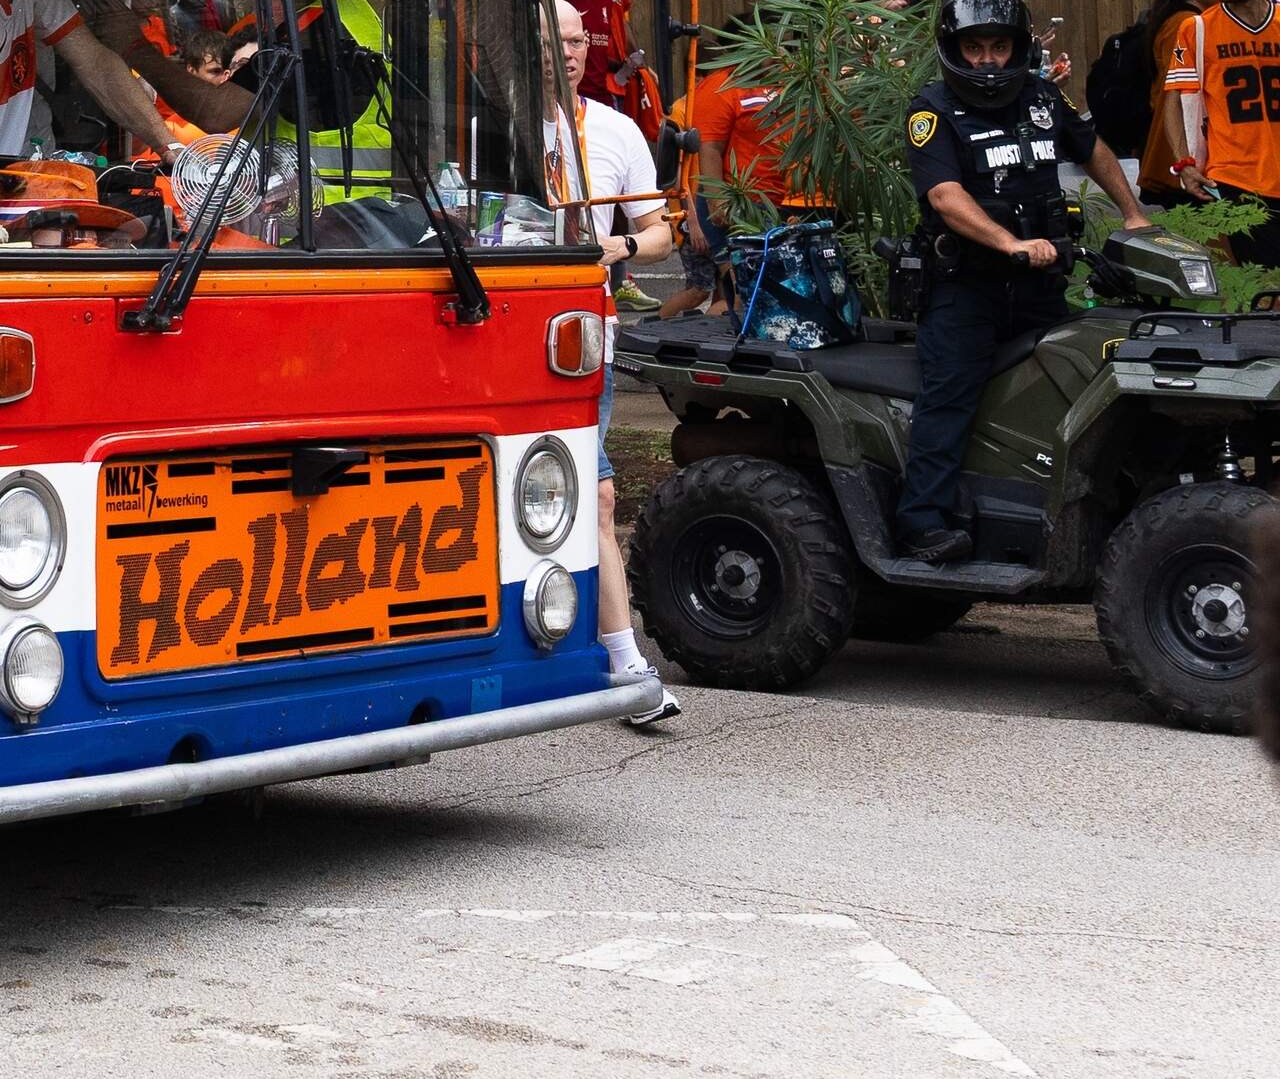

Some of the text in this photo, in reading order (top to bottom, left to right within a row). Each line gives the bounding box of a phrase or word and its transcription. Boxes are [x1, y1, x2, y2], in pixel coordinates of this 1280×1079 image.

[985, 144, 1021, 168] HOUST
[105, 465, 141, 497] MKZ
[106, 493, 208, 512] metaal bewerking
[110, 461, 488, 667] Holland
